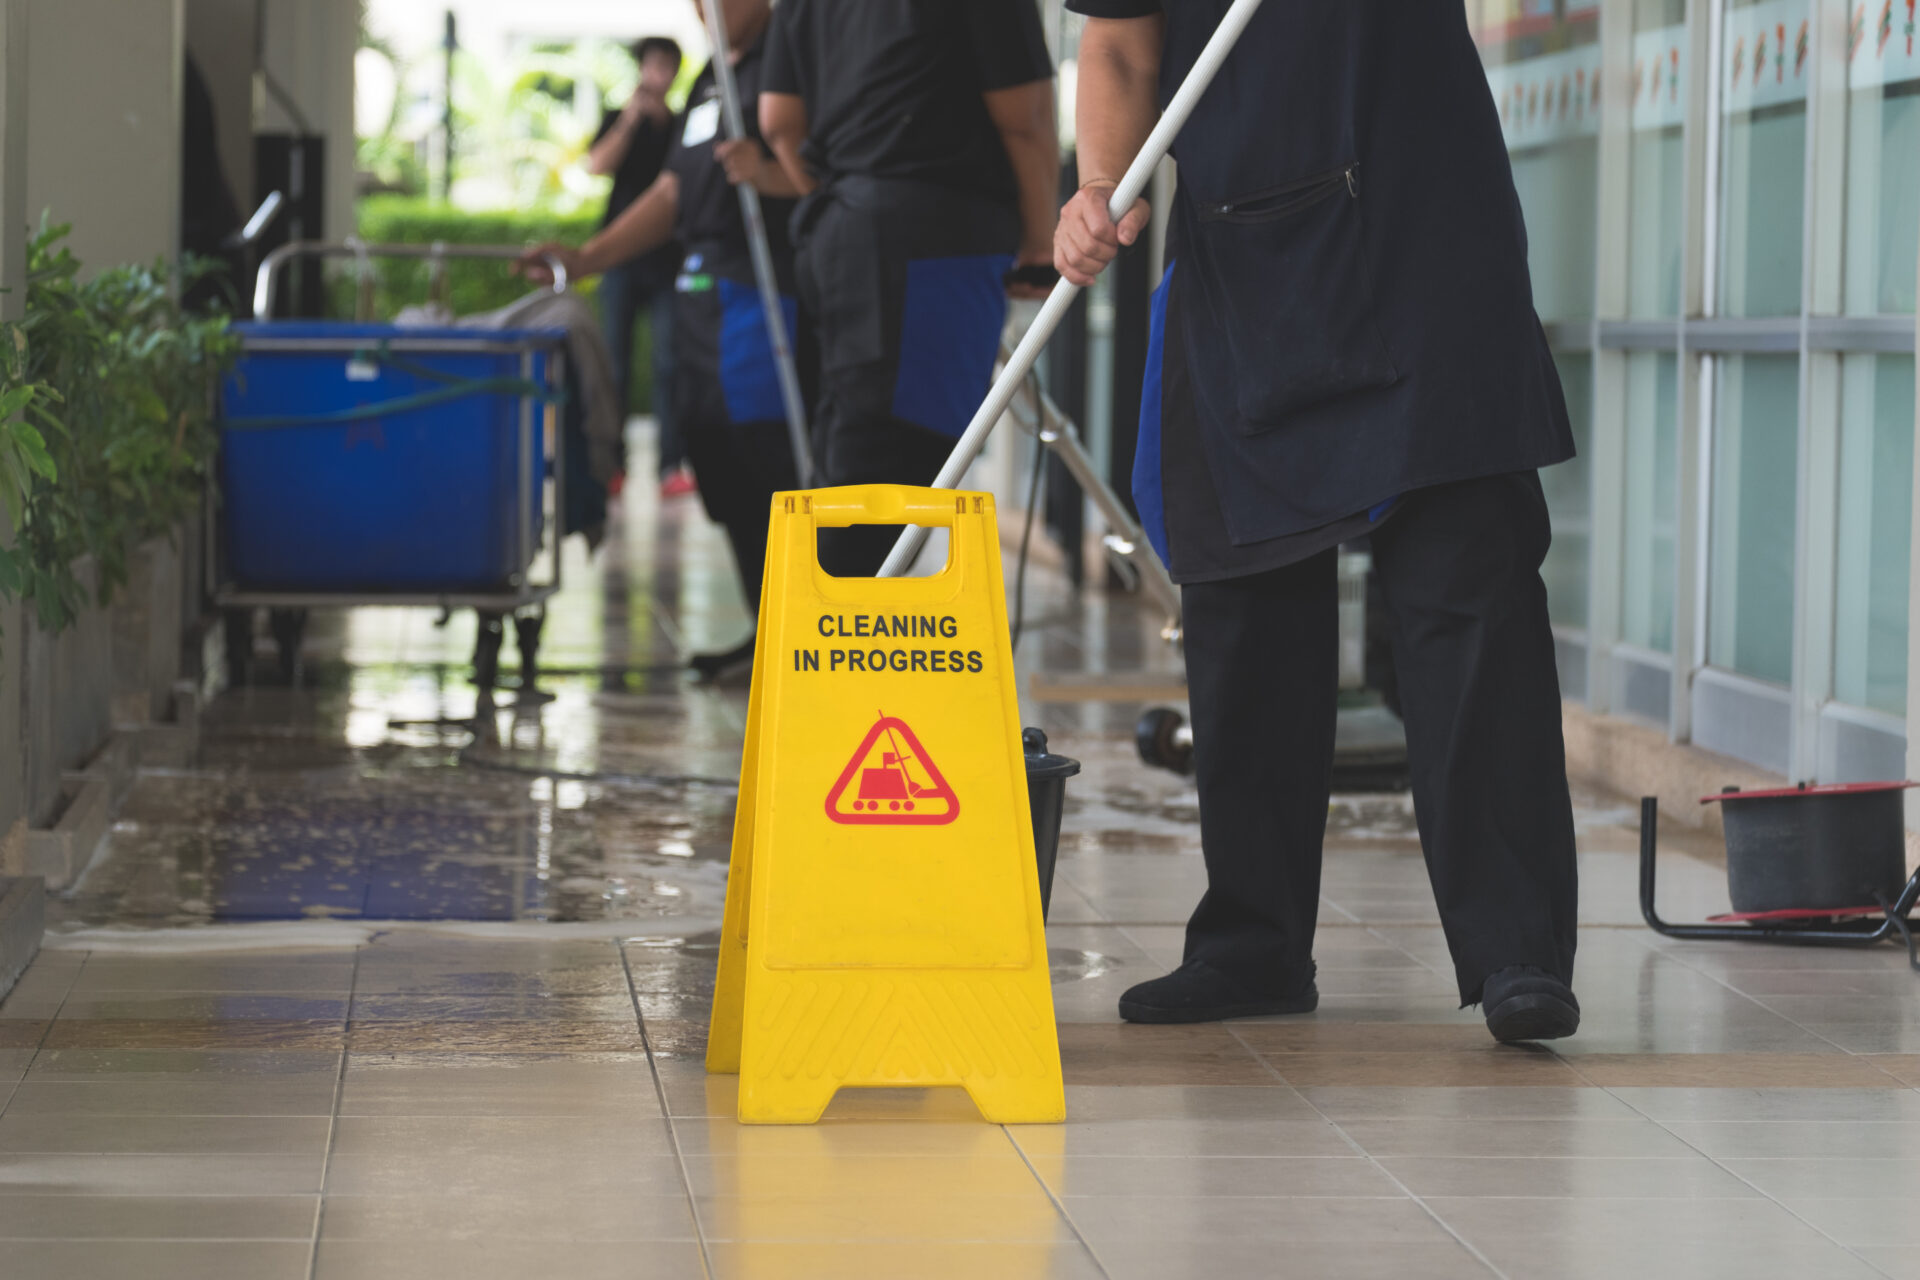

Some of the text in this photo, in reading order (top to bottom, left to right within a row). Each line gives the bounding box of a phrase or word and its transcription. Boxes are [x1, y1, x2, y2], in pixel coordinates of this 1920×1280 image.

[818, 614, 957, 638] CLEANING
[794, 649, 983, 673] IN PROGRESS
